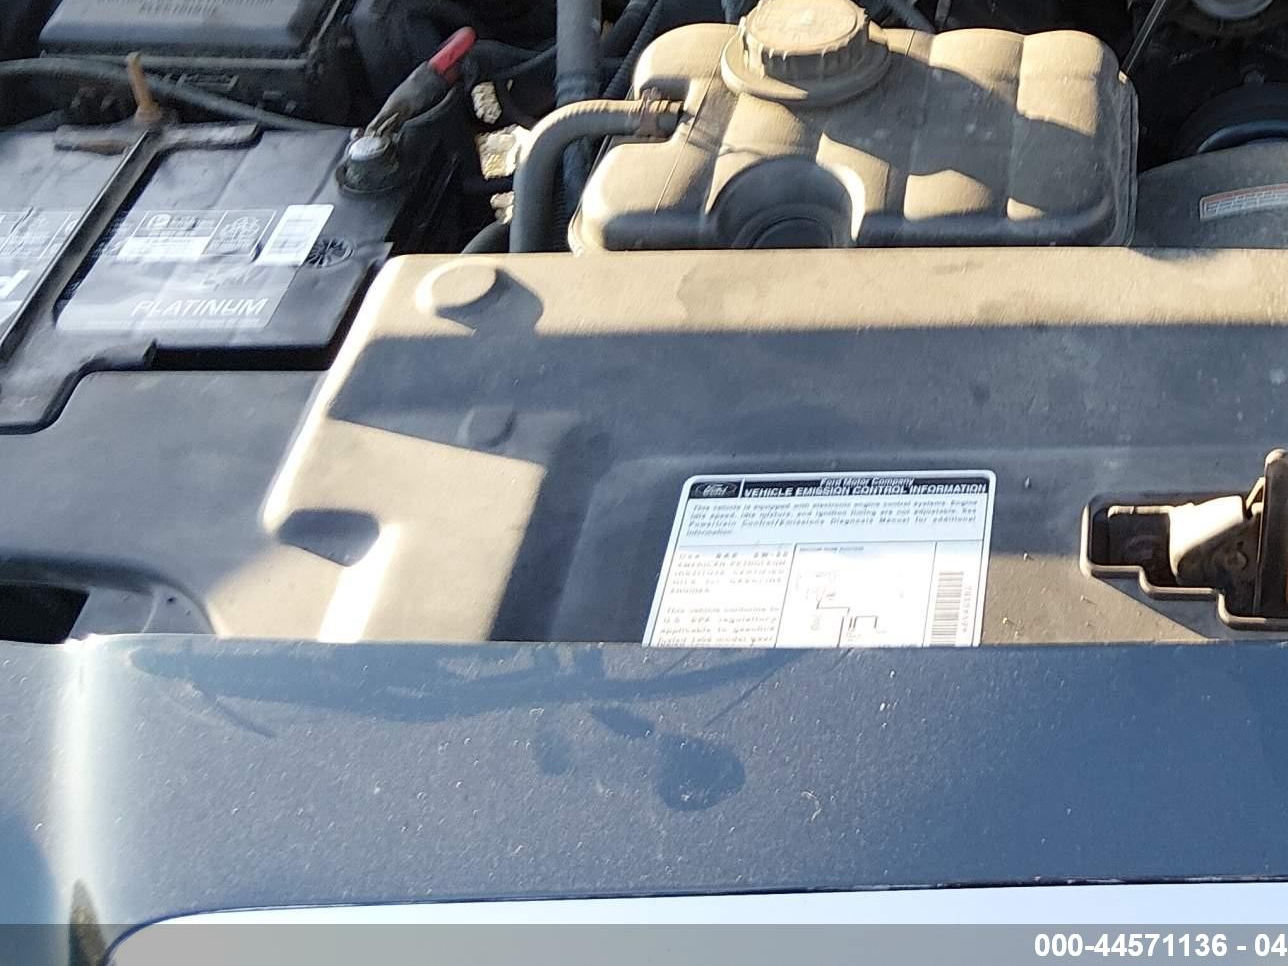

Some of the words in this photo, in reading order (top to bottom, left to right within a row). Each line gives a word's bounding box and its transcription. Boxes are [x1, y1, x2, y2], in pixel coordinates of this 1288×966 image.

[131, 298, 269, 317] PLATINUM
[819, 477, 841, 487] Ford
[843, 477, 870, 486] Motor
[872, 476, 916, 487] Company
[744, 486, 793, 498] VEHICLE
[795, 485, 850, 497] EMISSION
[852, 484, 908, 496] CONTROL
[909, 483, 986, 495] INFORMATION
